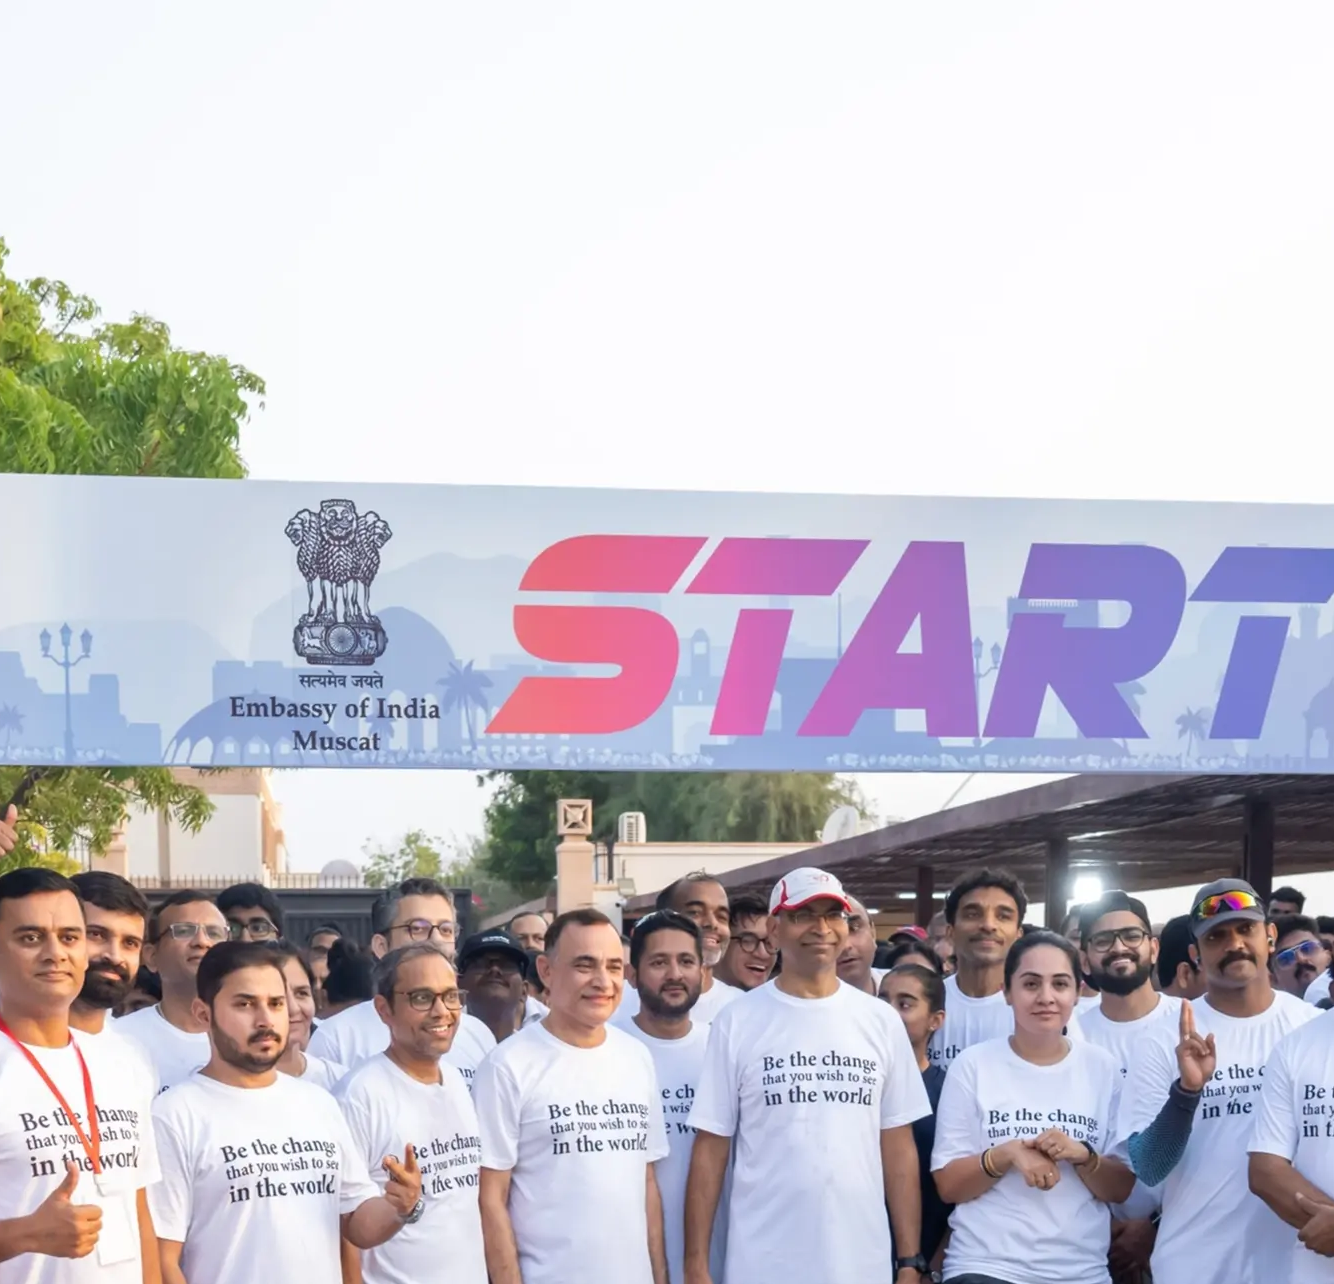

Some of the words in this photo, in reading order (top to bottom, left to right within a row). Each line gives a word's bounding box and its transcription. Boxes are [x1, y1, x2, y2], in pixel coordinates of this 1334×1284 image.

[299, 671, 347, 689] सत्यमेव
[351, 671, 384, 689] जयते
[229, 696, 338, 724] Embassy
[345, 698, 369, 718] of
[378, 697, 441, 720] India
[292, 730, 382, 751] Muscat
[763, 1056, 784, 1072] Be
[790, 1051, 817, 1067] the
[822, 1050, 877, 1074] change
[1228, 1064, 1255, 1079] the
[762, 1073, 786, 1086] that
[789, 1072, 812, 1085] you
[816, 1070, 844, 1081] wish
[848, 1072, 860, 1082] to
[862, 1075, 877, 1085] see
[764, 1090, 782, 1106] in
[788, 1085, 818, 1103] the
[823, 1087, 872, 1106] world
[1201, 1085, 1226, 1098] that
[1229, 1084, 1249, 1098] you
[1303, 1084, 1326, 1100] Be
[548, 1103, 571, 1120] Be
[576, 1100, 598, 1116] the
[1202, 1103, 1221, 1120] in
[1227, 1098, 1253, 1115] the
[1302, 1103, 1326, 1116] that
[19, 1112, 50, 1132] Be
[550, 1122, 575, 1135] that
[577, 1121, 596, 1134] you
[599, 1117, 624, 1131] wish
[627, 1119, 637, 1129] to
[988, 1110, 1010, 1125] Be
[1016, 1108, 1043, 1122] the
[1048, 1109, 1099, 1131] change
[1303, 1120, 1319, 1138] in
[26, 1134, 57, 1150] that
[120, 1128, 131, 1139] to
[553, 1138, 570, 1155] in
[576, 1135, 603, 1153] the
[988, 1126, 1011, 1139] that
[1014, 1126, 1038, 1140] you
[1073, 1129, 1084, 1140] to
[1086, 1133, 1099, 1144] see
[220, 1145, 248, 1163] Be
[251, 1139, 278, 1155] the
[282, 1137, 336, 1158] change
[30, 1156, 56, 1177] in
[226, 1162, 254, 1180] that
[256, 1162, 279, 1177] you
[281, 1157, 308, 1171] wish
[312, 1158, 323, 1169] to
[433, 1161, 448, 1175] you
[229, 1186, 250, 1203] in
[256, 1176, 287, 1198] the
[432, 1175, 453, 1195] the
